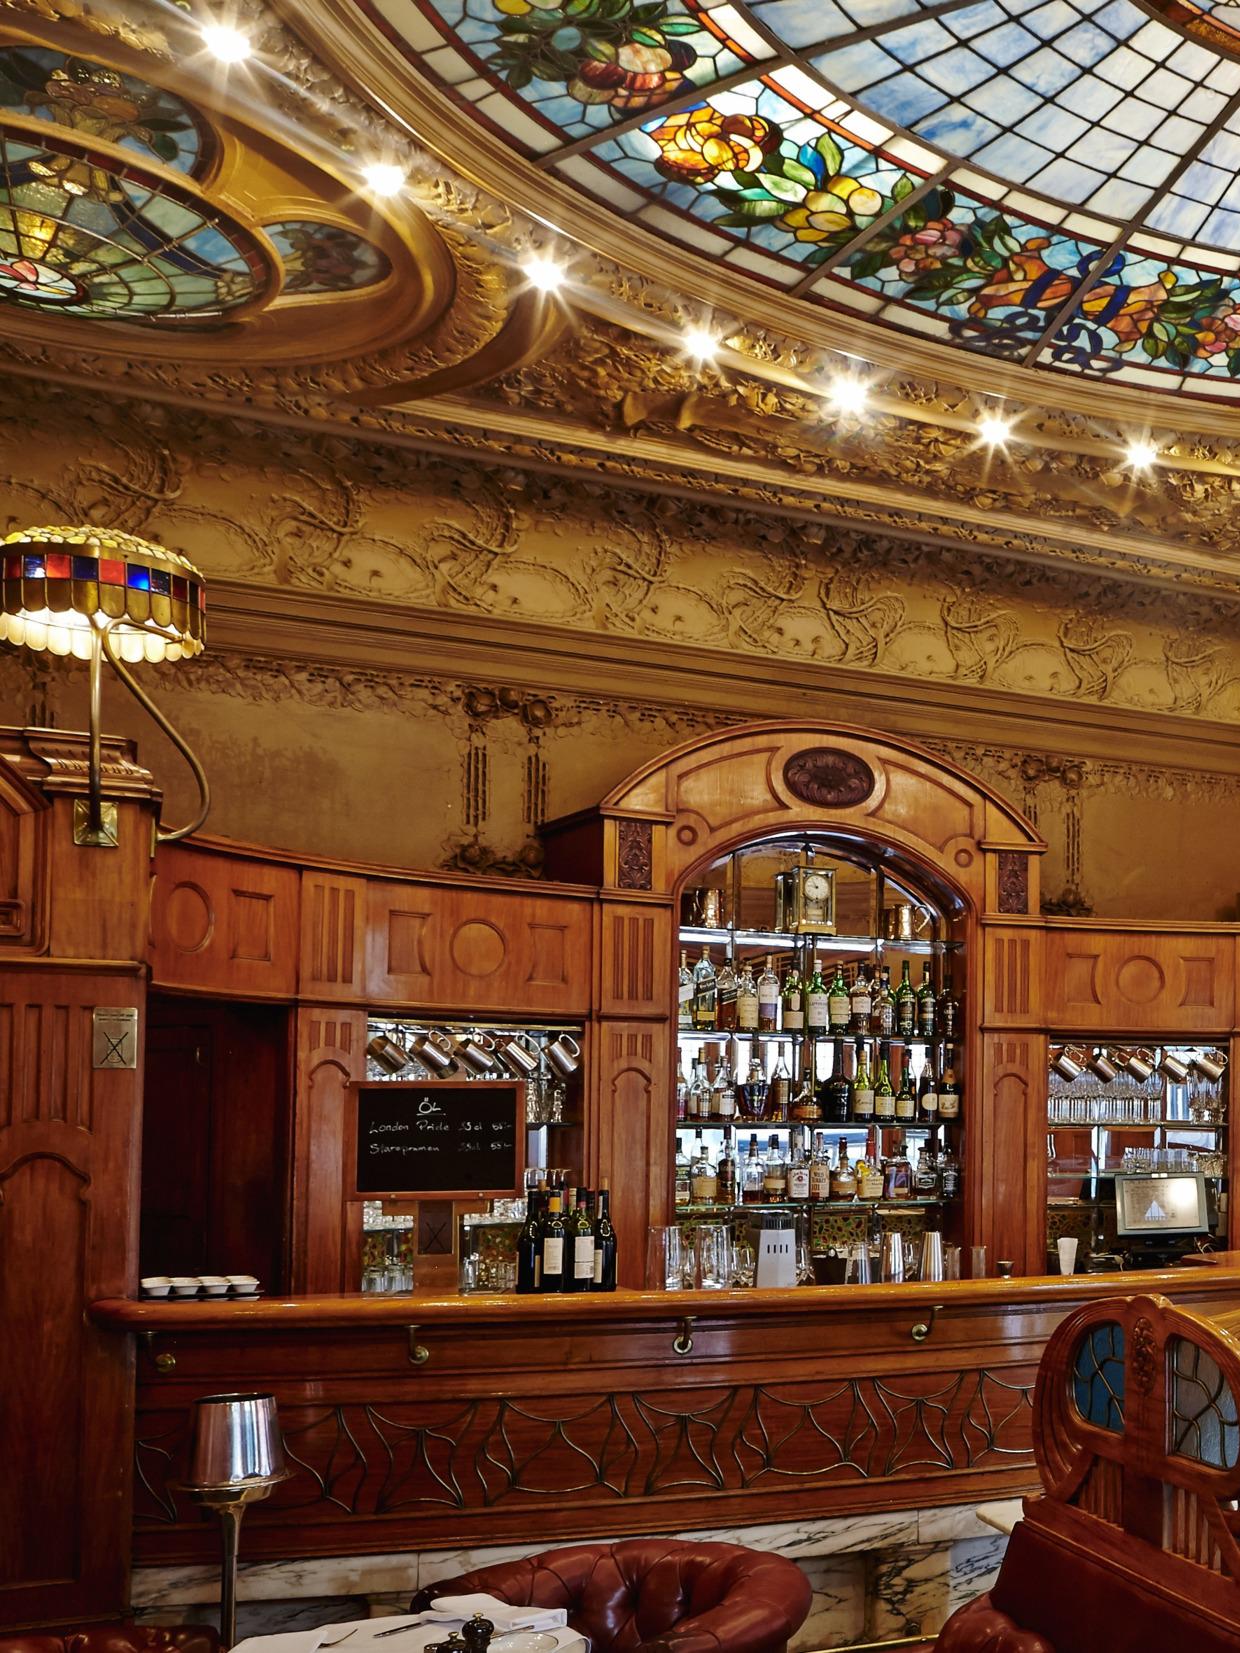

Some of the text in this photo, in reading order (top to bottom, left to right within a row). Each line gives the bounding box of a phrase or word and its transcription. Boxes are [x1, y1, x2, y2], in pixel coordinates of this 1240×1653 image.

[418, 1096, 442, 1114] ÖL
[369, 1121, 409, 1135] London
[416, 1119, 449, 1131] Pride
